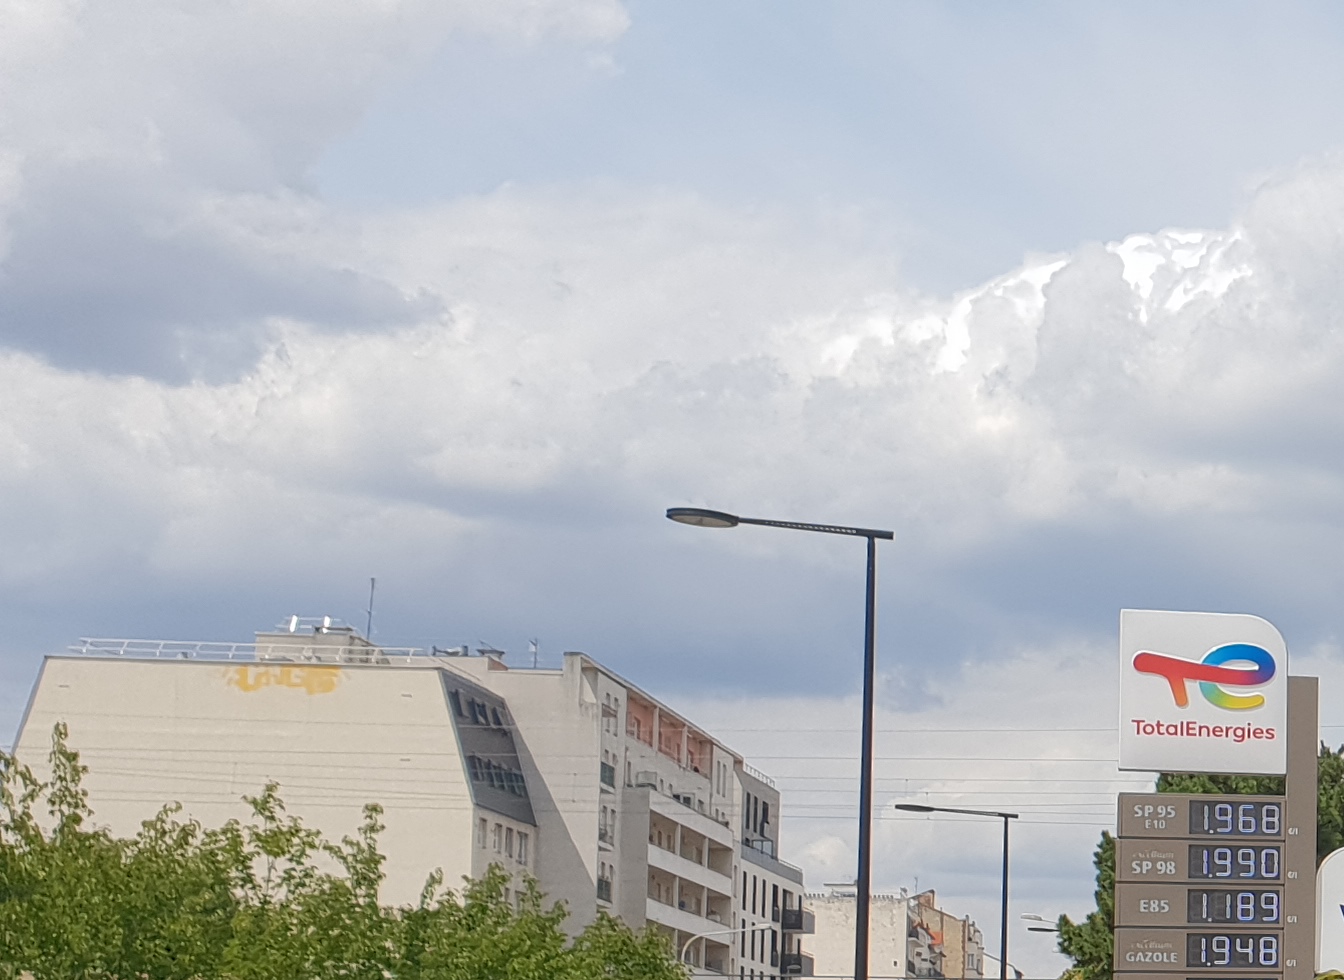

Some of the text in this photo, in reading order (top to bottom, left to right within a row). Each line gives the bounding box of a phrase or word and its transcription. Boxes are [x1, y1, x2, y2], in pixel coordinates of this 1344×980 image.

[1131, 719, 1276, 743] TotalEnergies
[1133, 803, 1280, 834] SP 95 1.968
[1144, 820, 1166, 829] E10
[1131, 848, 1279, 878] SP 98 1.990
[1139, 899, 1170, 913] E85
[1126, 935, 1278, 967] GAZOLE 1.948
